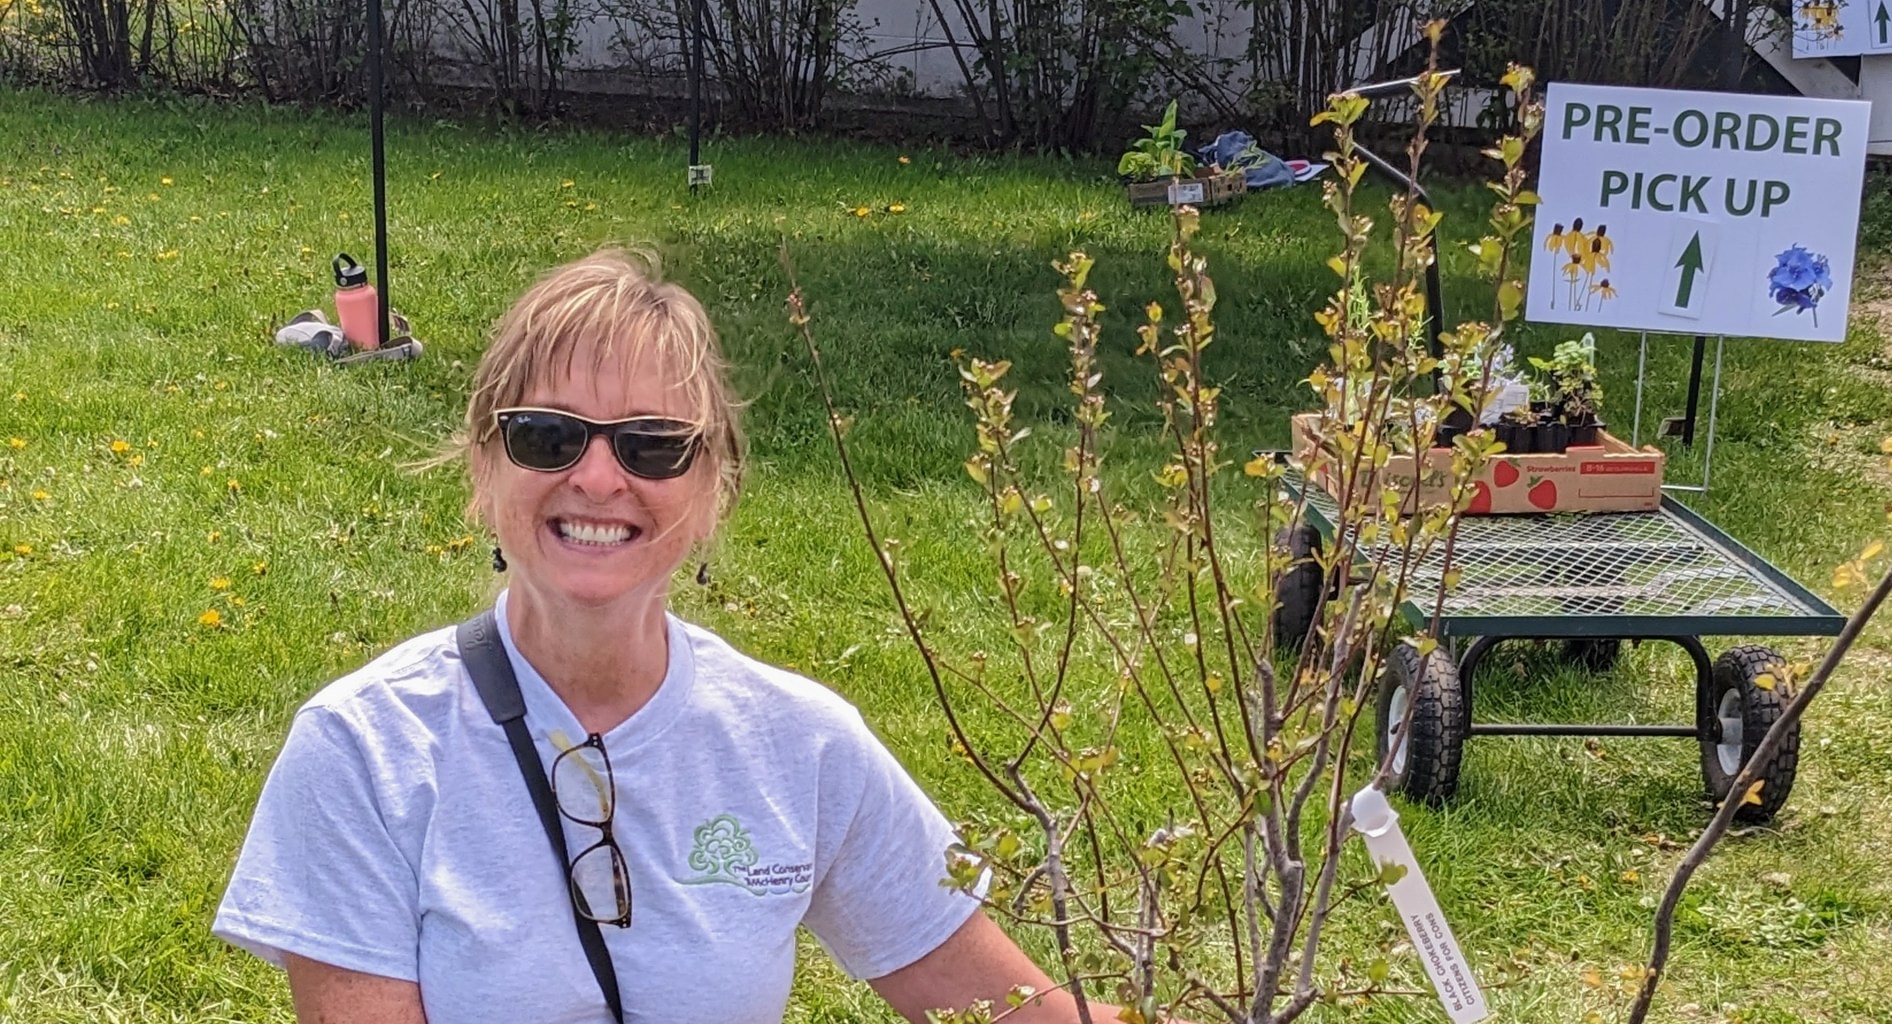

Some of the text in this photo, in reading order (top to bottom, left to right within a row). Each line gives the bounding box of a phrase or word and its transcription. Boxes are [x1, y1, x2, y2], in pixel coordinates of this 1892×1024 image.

[1562, 102, 1842, 157] PRE-ORDER
[1600, 170, 1791, 218] PICK UP
[1526, 465, 1576, 473] Strawberries
[747, 865, 770, 877] Land
[1411, 914, 1463, 1011] BLACK CHOKEBERRY
[1425, 913, 1475, 1005] CITIZENS FOR CONS
